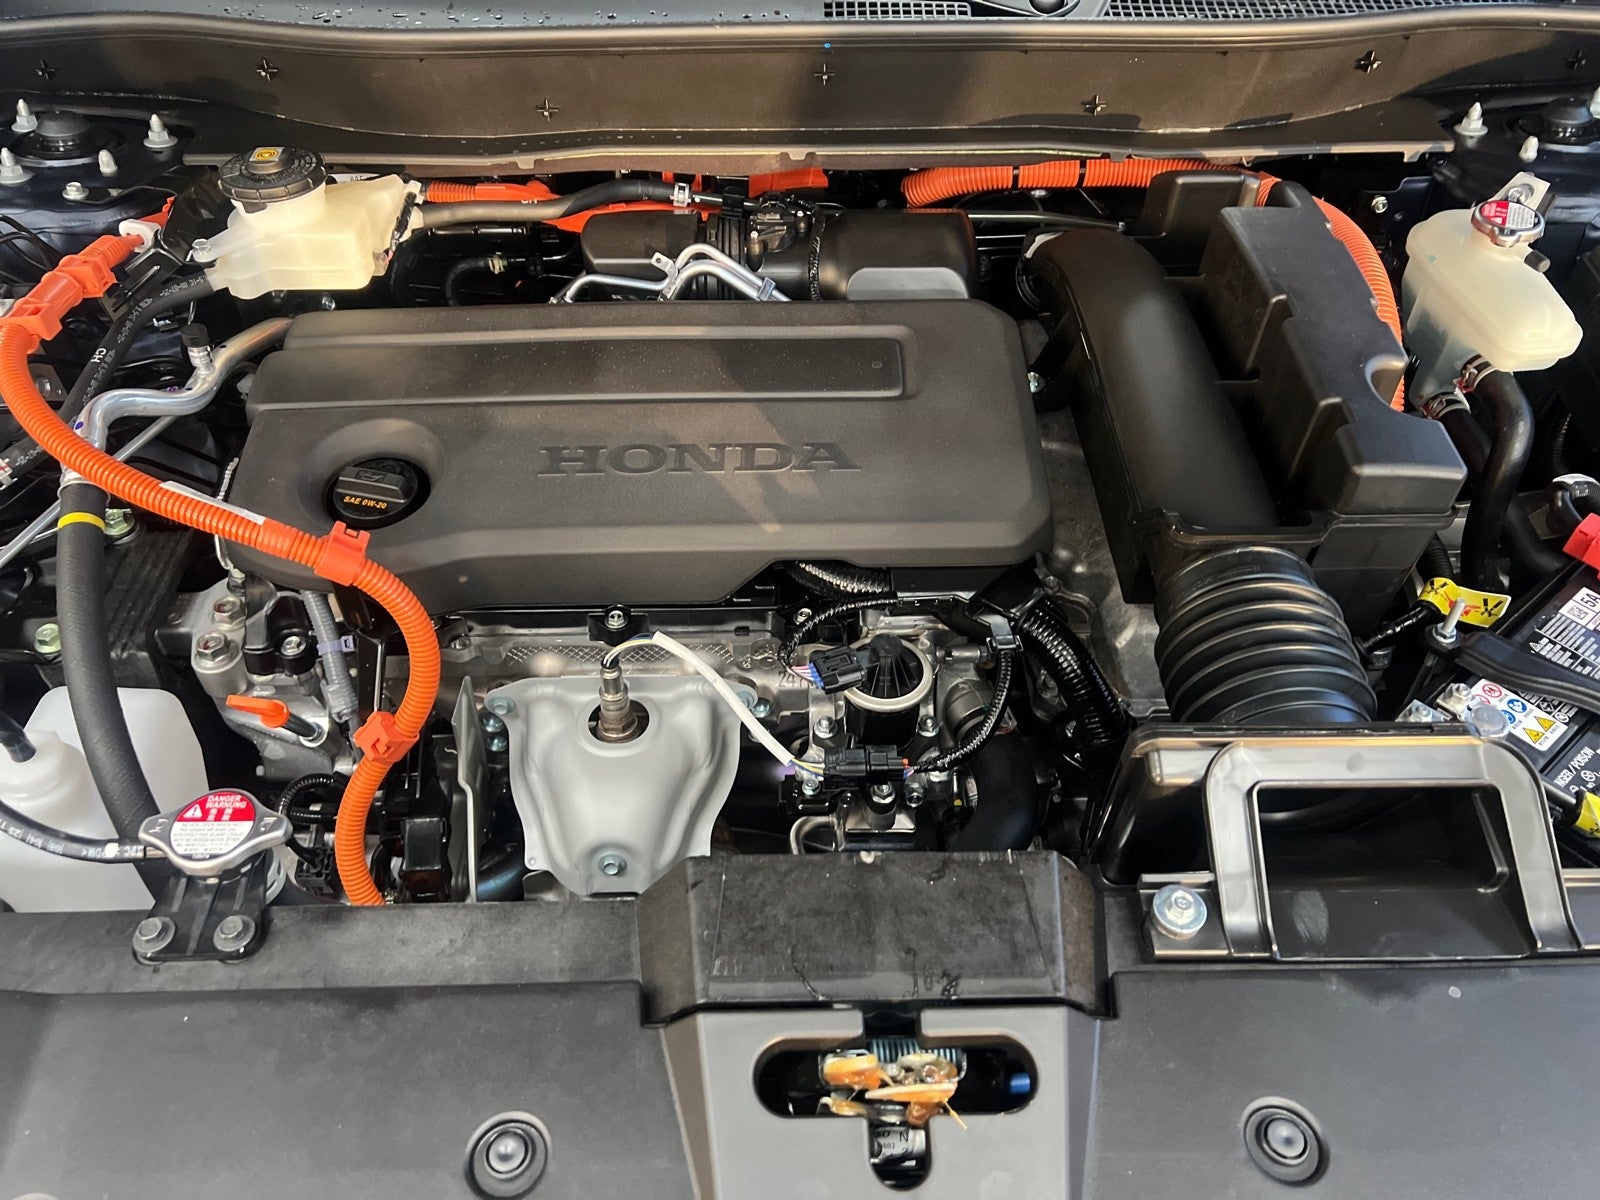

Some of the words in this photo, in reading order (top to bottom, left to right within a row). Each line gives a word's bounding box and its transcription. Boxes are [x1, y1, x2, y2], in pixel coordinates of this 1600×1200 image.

[90, 348, 107, 363] CH
[537, 442, 862, 476] HONDA
[343, 495, 362, 505] SAE
[362, 499, 388, 509] 0W-20
[1553, 746, 1595, 788] NGER/POISON
[207, 794, 242, 802] DANGER
